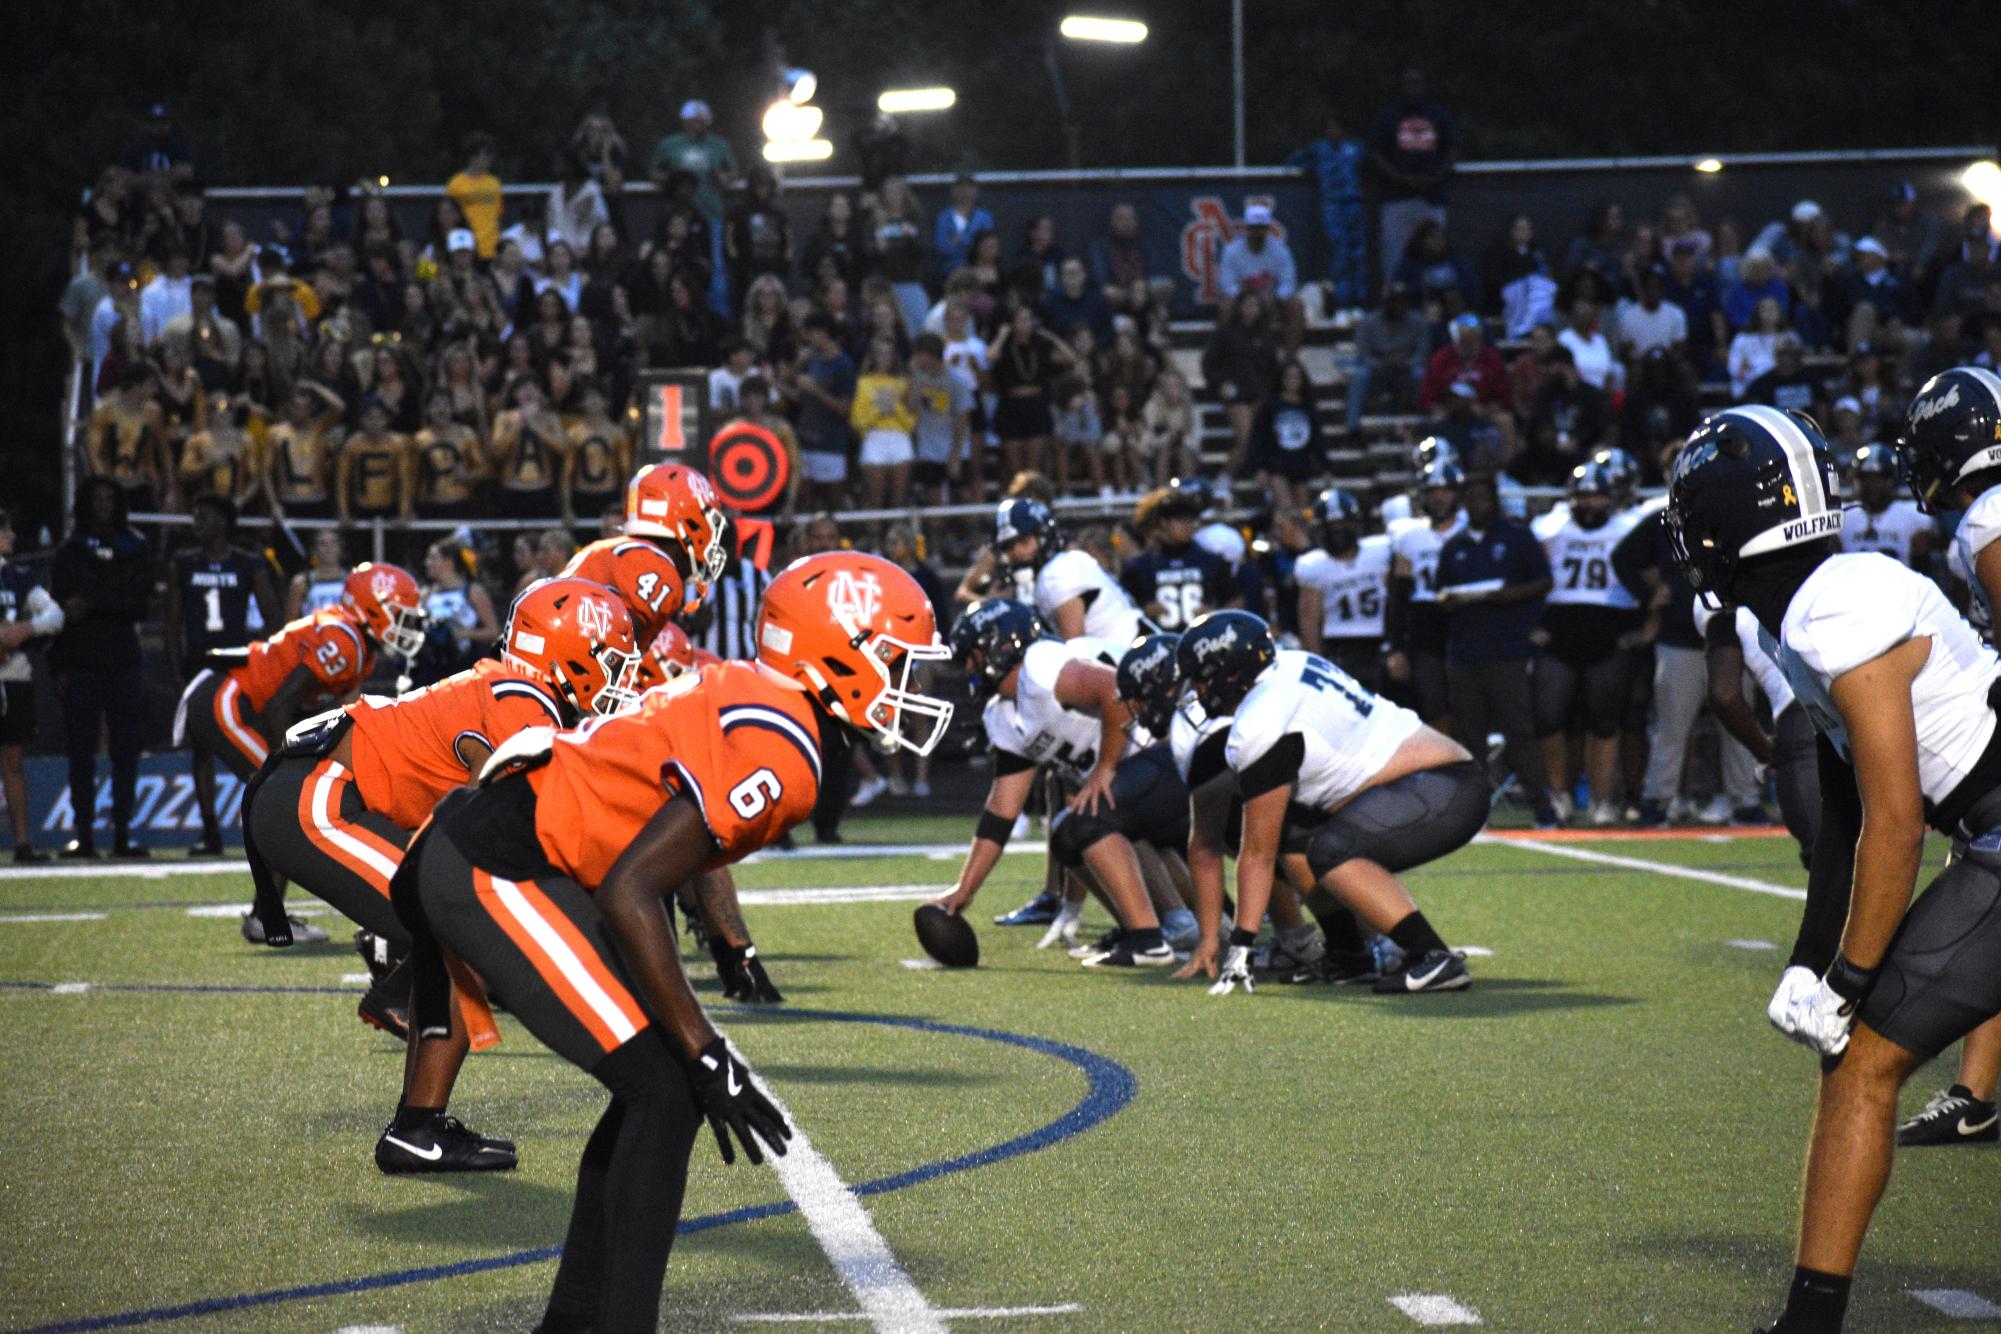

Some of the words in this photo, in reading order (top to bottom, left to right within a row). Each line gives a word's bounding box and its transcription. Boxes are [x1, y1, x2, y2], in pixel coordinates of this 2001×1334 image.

[659, 384, 687, 450] 1
[1783, 512, 1842, 542] WOLFPACK
[204, 588, 225, 632] 1
[636, 571, 672, 614] 41
[1338, 587, 1380, 621] 15
[315, 640, 347, 677] 23
[727, 766, 784, 821] 6
